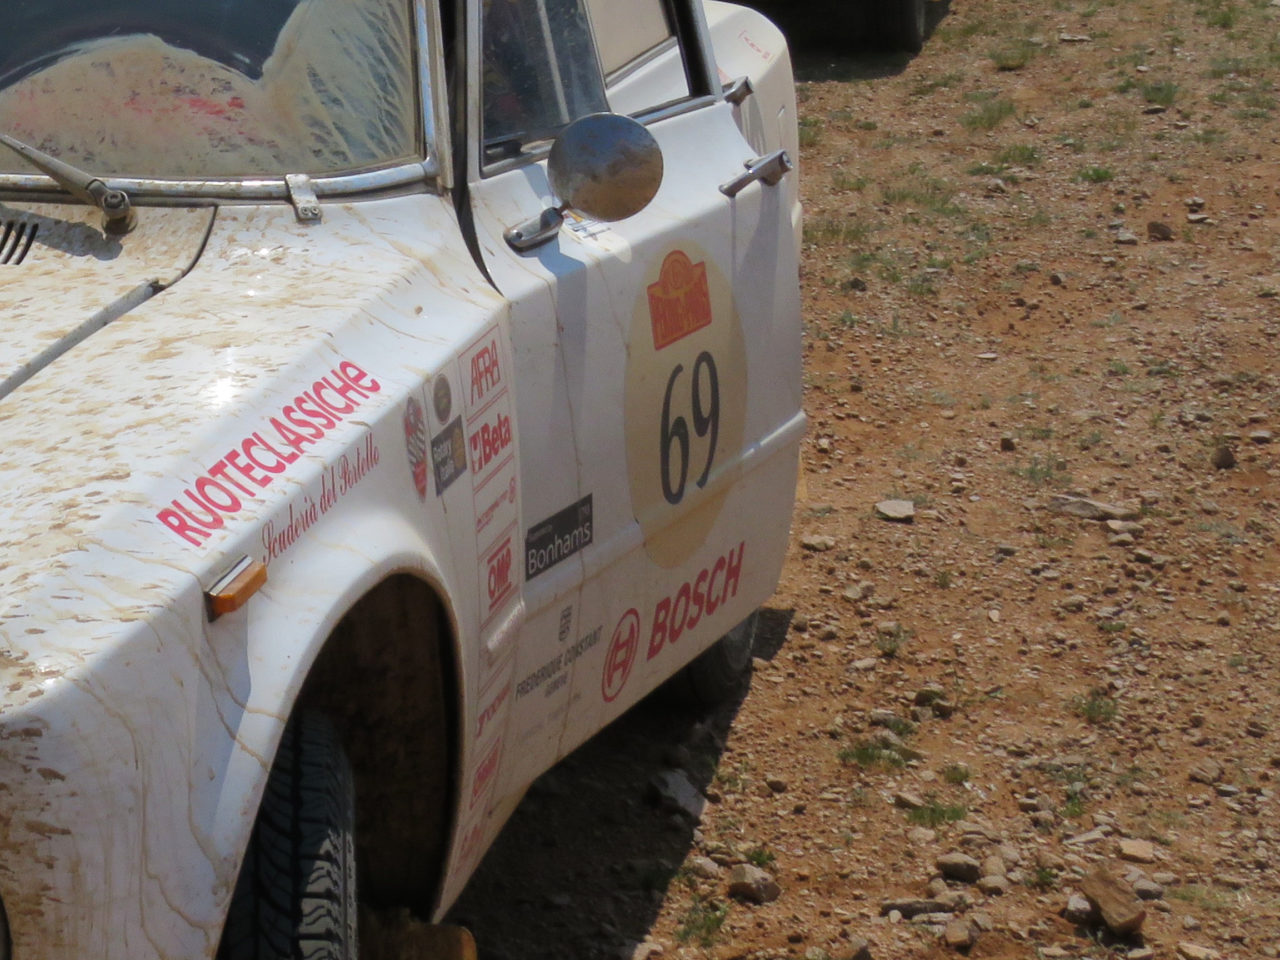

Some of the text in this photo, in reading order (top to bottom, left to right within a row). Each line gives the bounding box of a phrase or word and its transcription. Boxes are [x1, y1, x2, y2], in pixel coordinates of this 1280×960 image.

[470, 339, 501, 406] AFRA
[481, 413, 512, 465] Beta
[660, 351, 720, 505] 69
[260, 432, 380, 567] Scuderia del Portello
[487, 545, 513, 600] OMP
[528, 521, 592, 575] Bonhams
[646, 541, 745, 662] BOSCH
